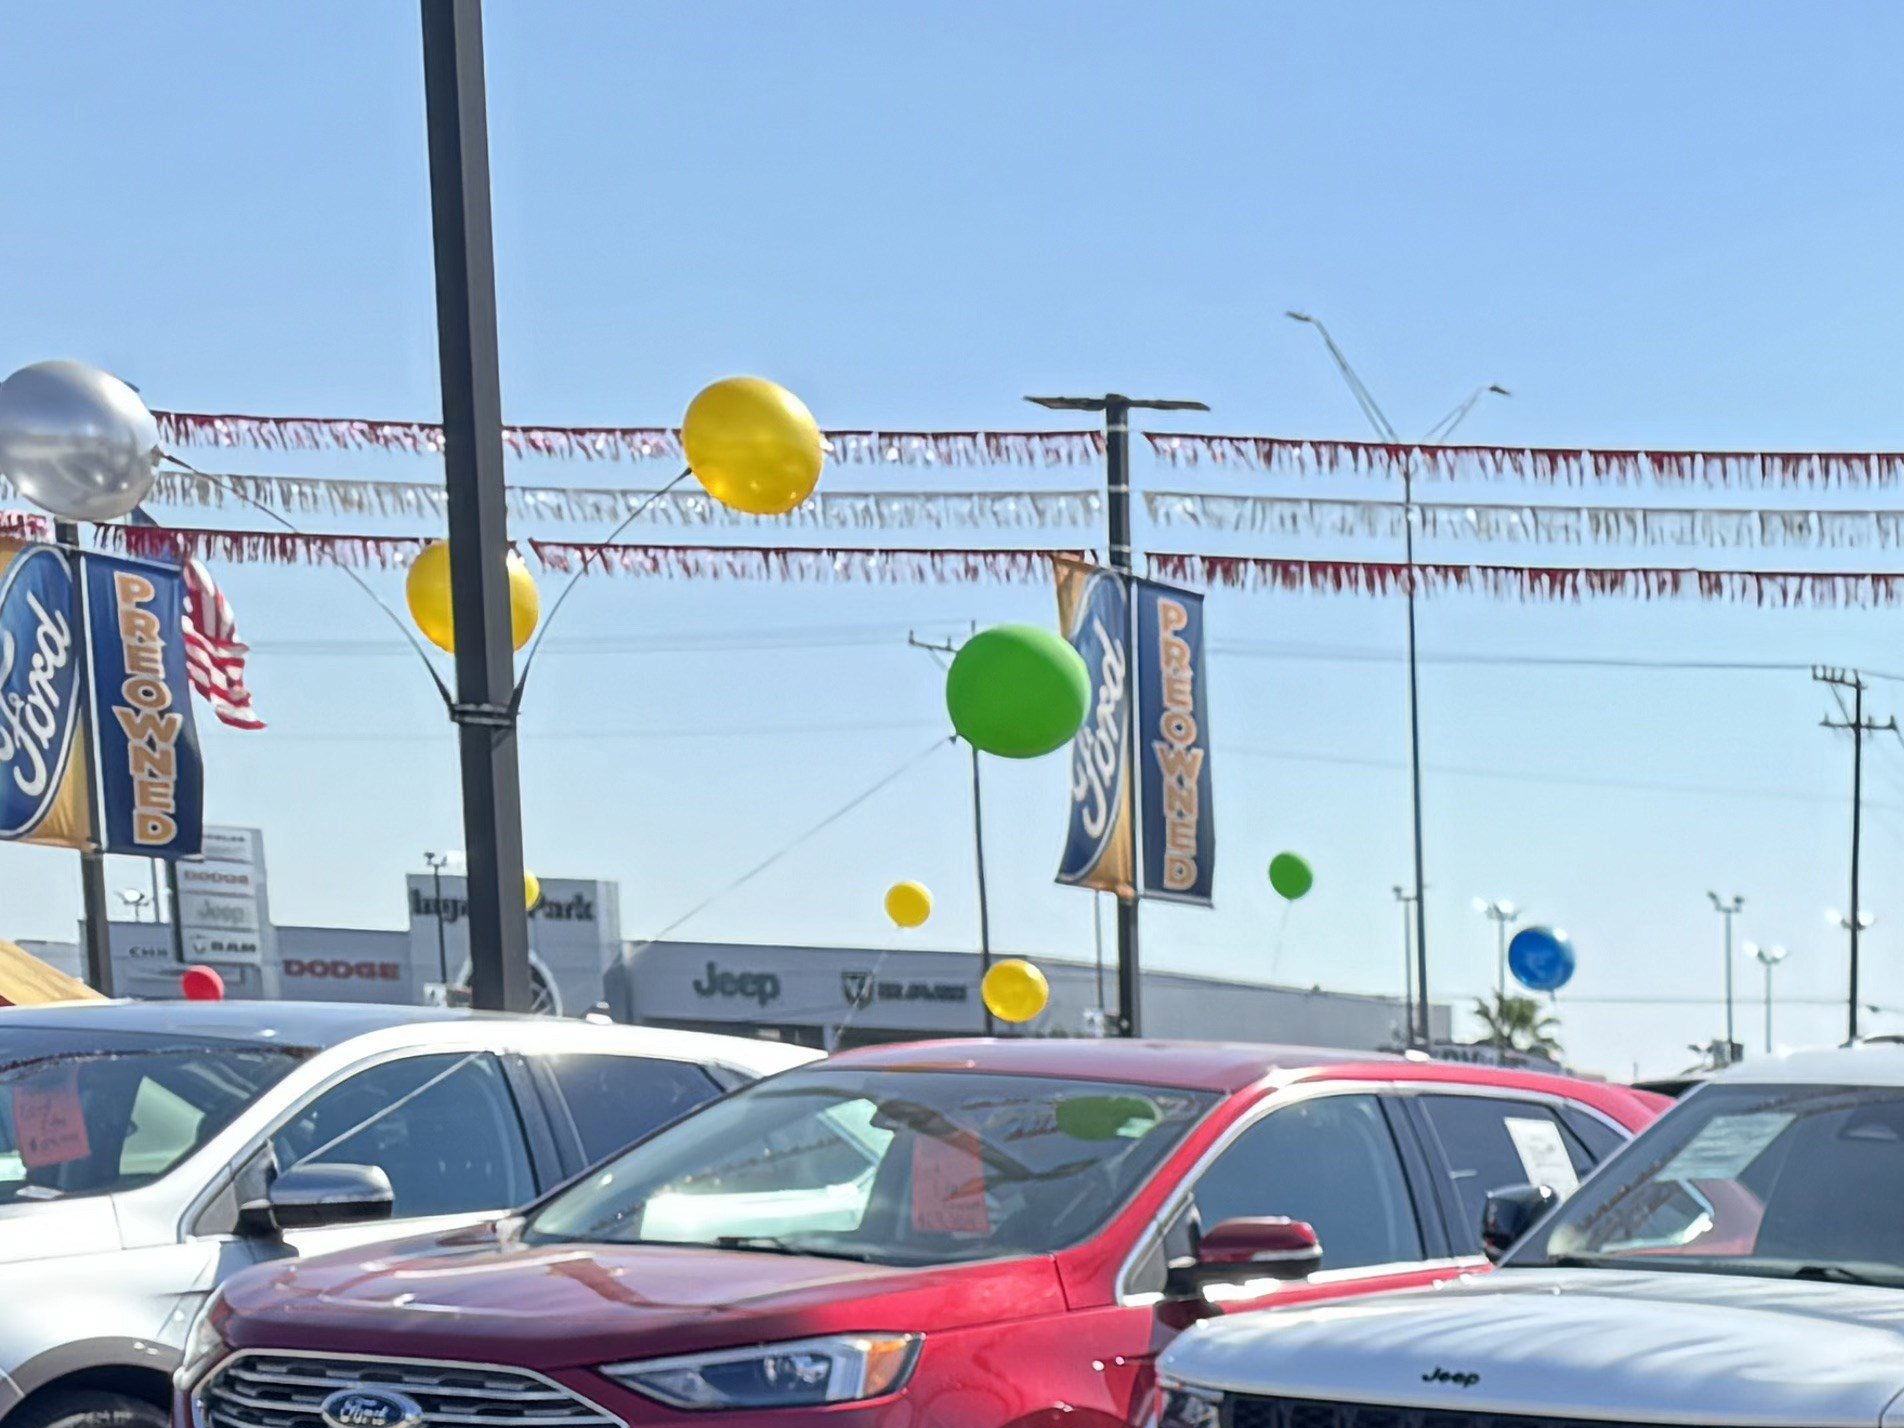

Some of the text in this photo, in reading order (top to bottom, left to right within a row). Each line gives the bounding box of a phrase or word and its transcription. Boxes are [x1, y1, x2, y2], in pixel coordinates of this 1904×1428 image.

[113, 570, 183, 845] PREOWNED
[1153, 596, 1204, 891] PREOWNED
[283, 958, 399, 981] DODGE
[692, 961, 780, 1007] Jeep
[1421, 1365, 1481, 1388] Jeep
